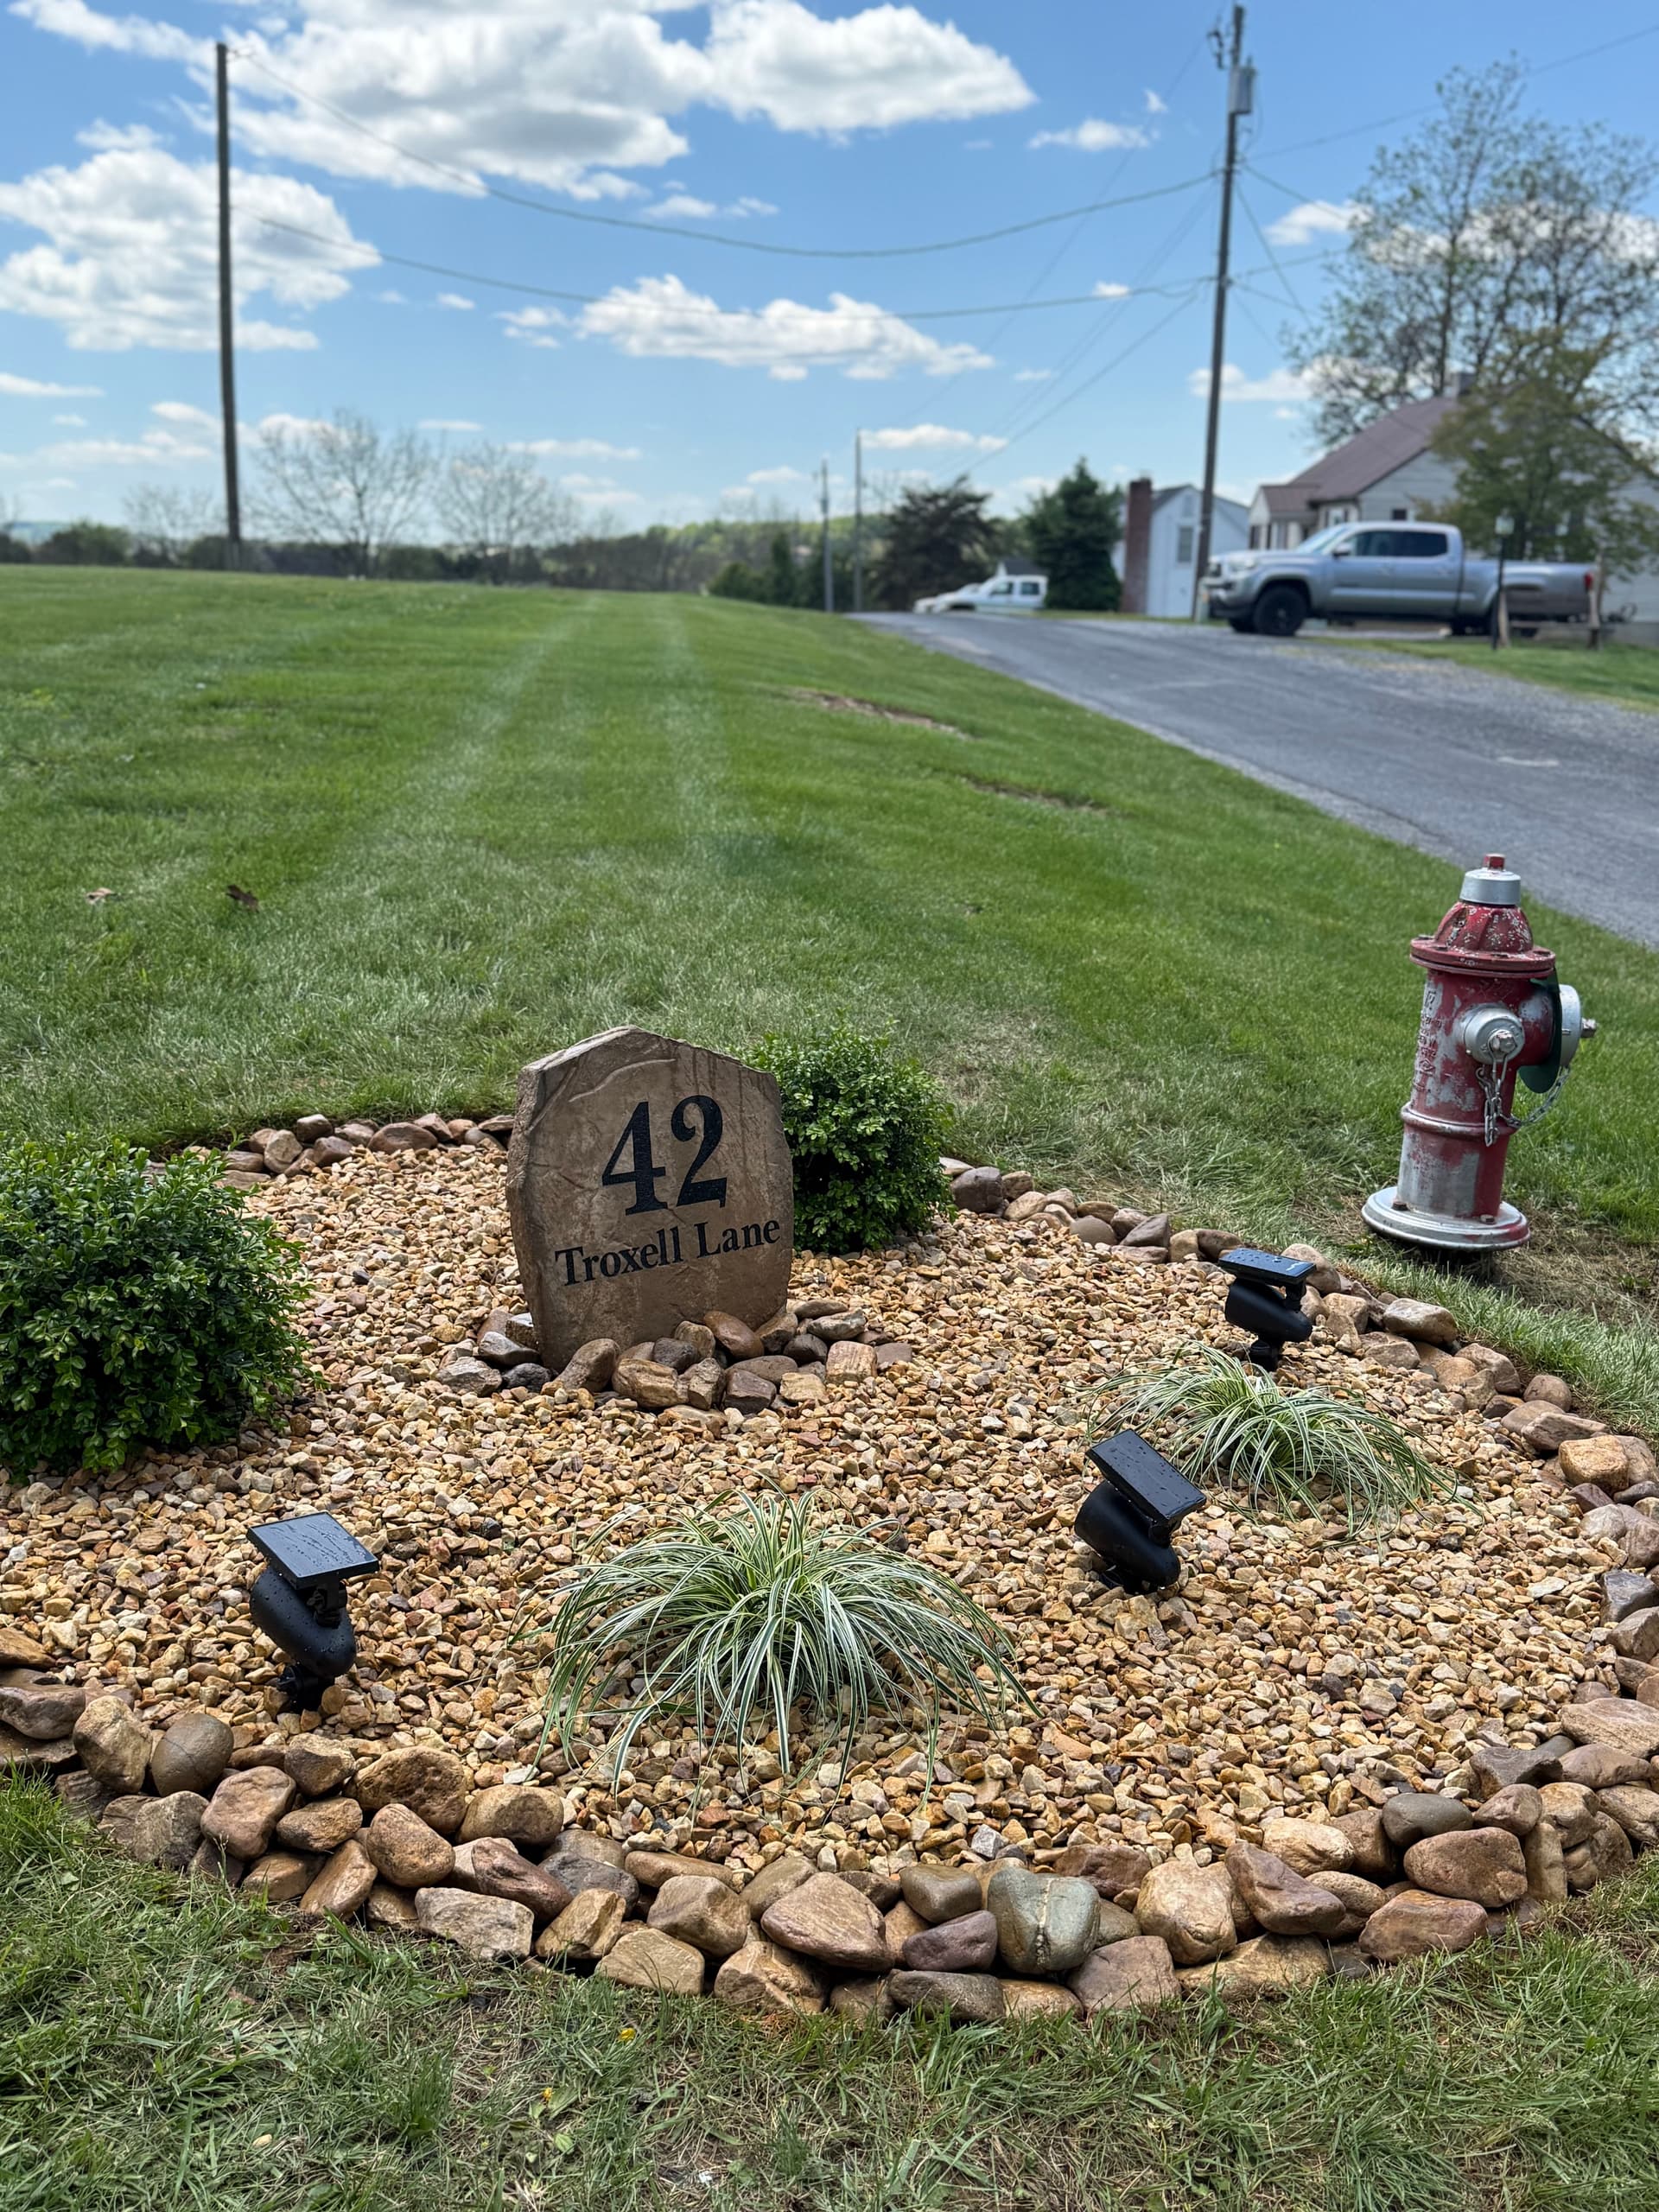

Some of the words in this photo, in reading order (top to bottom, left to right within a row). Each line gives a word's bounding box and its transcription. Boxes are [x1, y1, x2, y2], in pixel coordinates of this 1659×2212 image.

[602, 1095, 728, 1215] 42
[555, 1225, 684, 1287] Troxell
[695, 1219, 781, 1259] Lane
